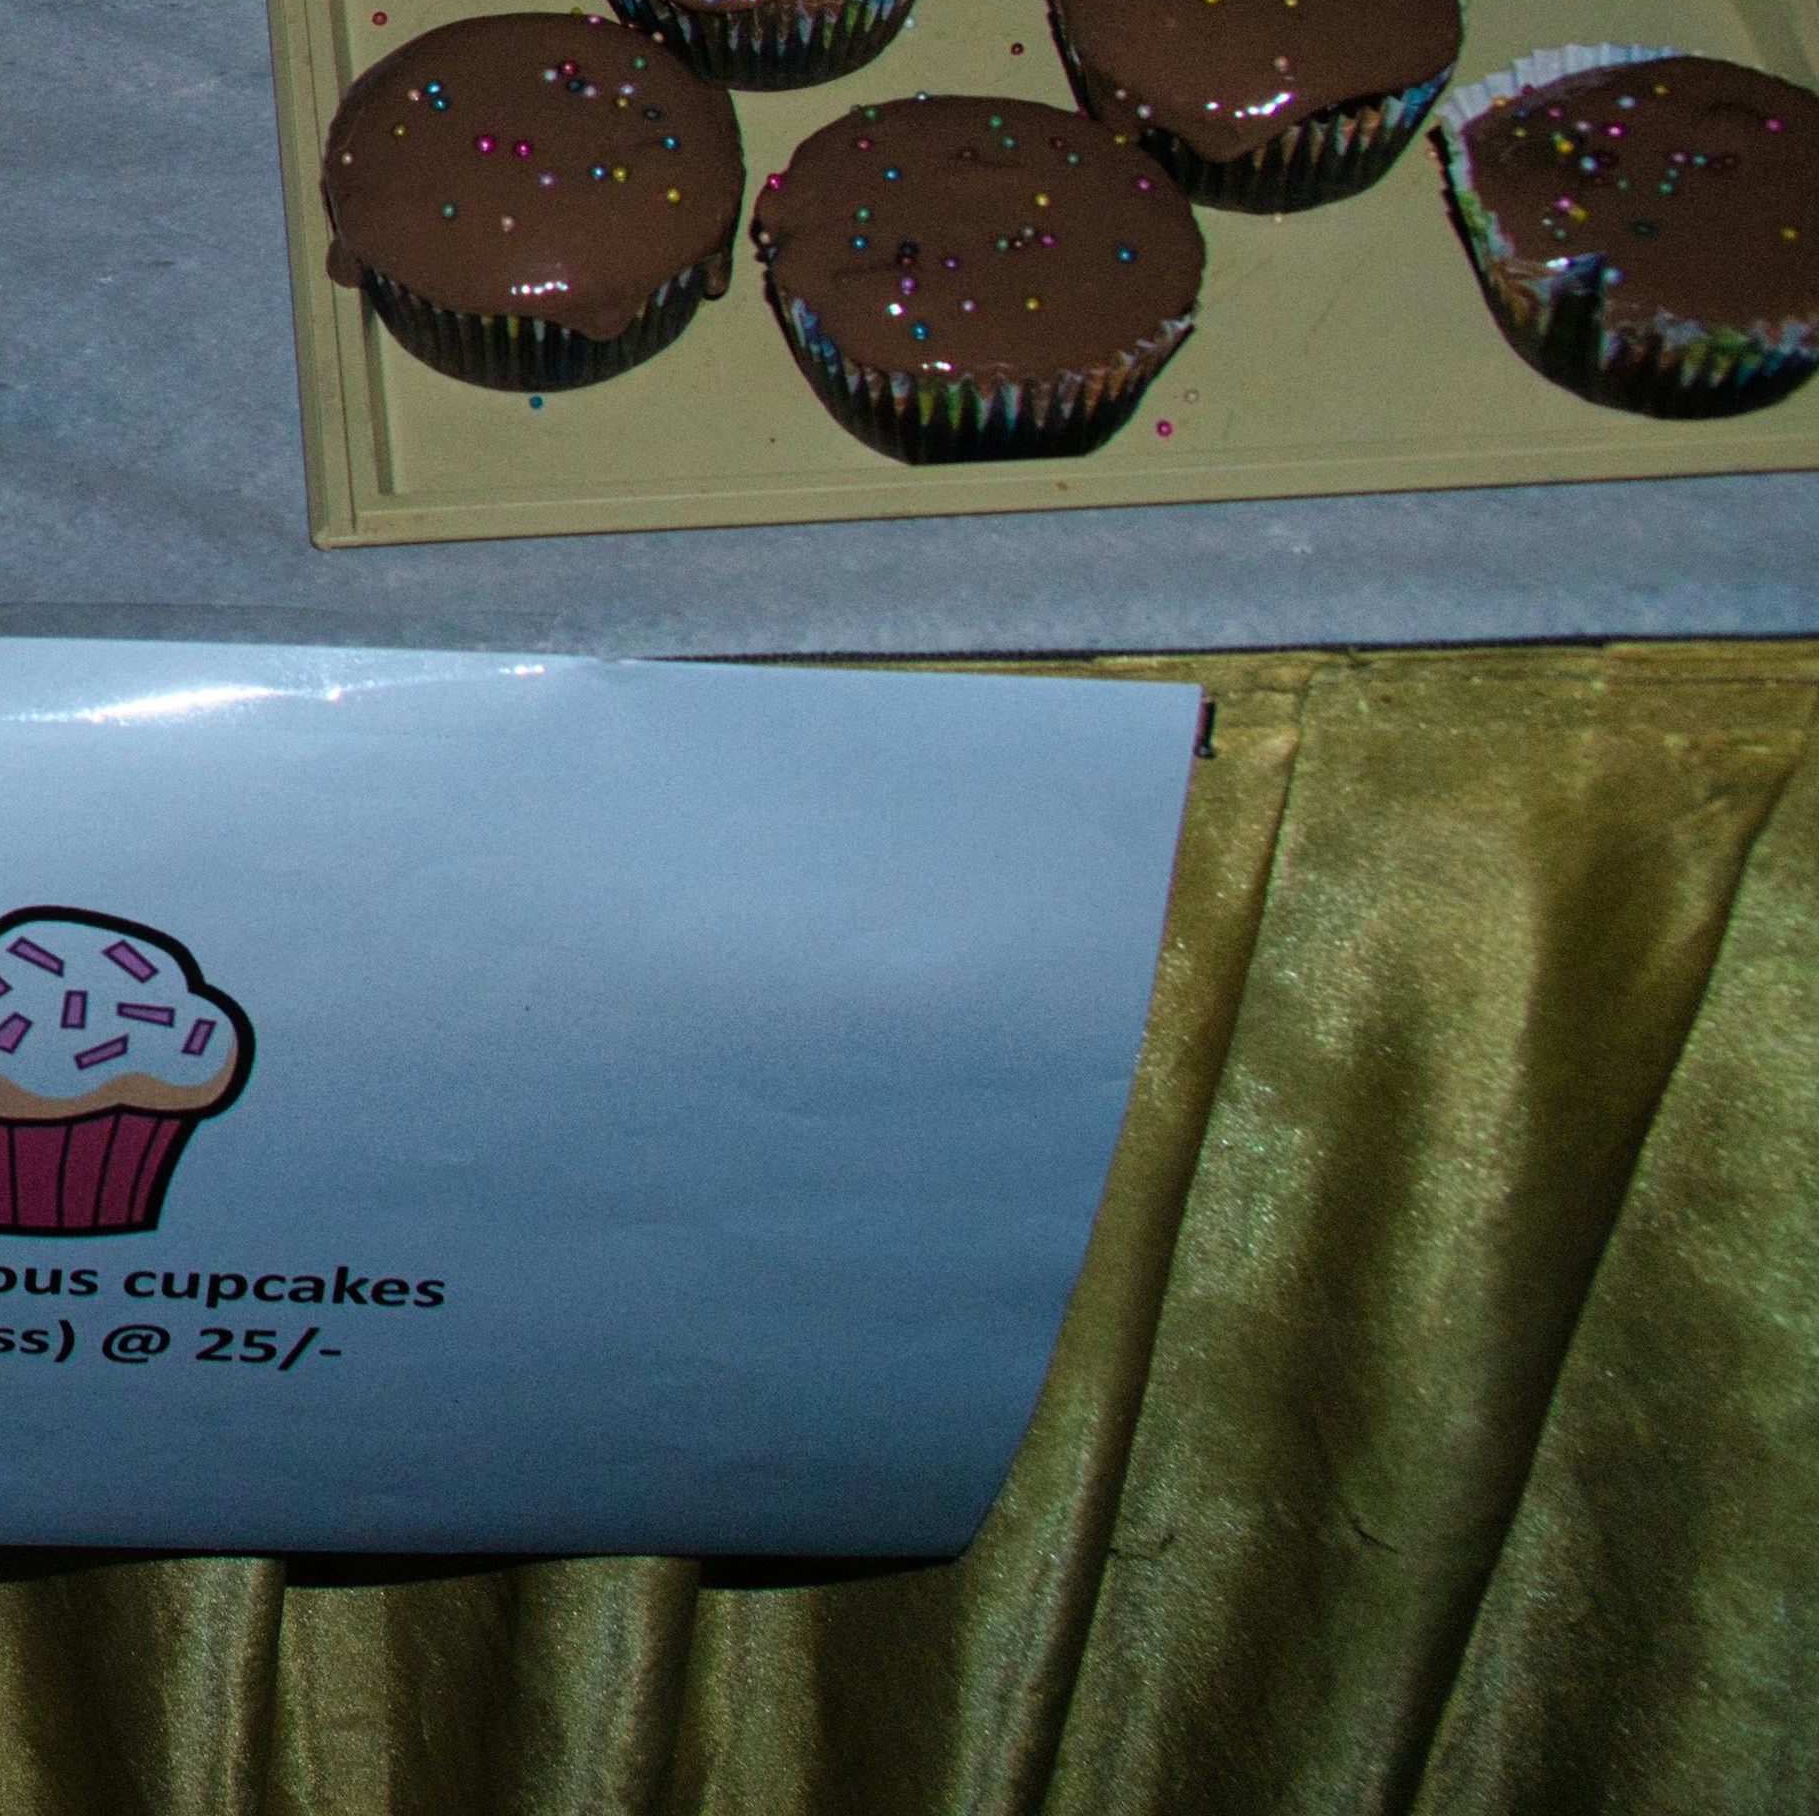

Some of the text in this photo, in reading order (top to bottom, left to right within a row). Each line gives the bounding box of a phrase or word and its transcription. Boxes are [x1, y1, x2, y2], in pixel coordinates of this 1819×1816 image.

[123, 1265, 446, 1309] cupcakes
[102, 1321, 171, 1362] @
[194, 1325, 343, 1370] 25/-
